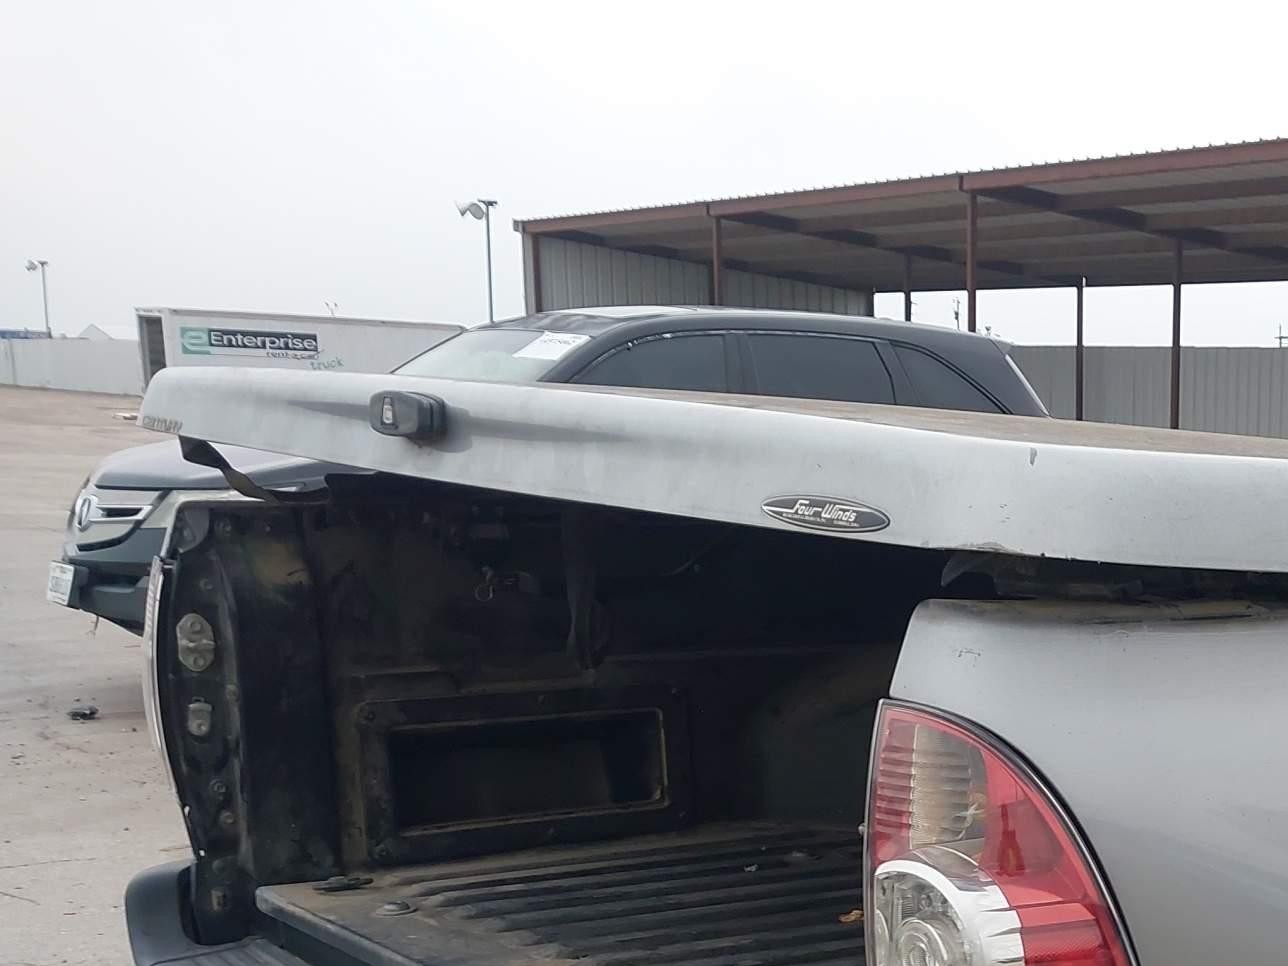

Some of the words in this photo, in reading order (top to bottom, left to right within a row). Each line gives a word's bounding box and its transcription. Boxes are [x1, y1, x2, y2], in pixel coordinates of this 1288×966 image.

[210, 331, 317, 350] Enterprise
[310, 356, 344, 370] truck
[821, 503, 858, 522] Winds
